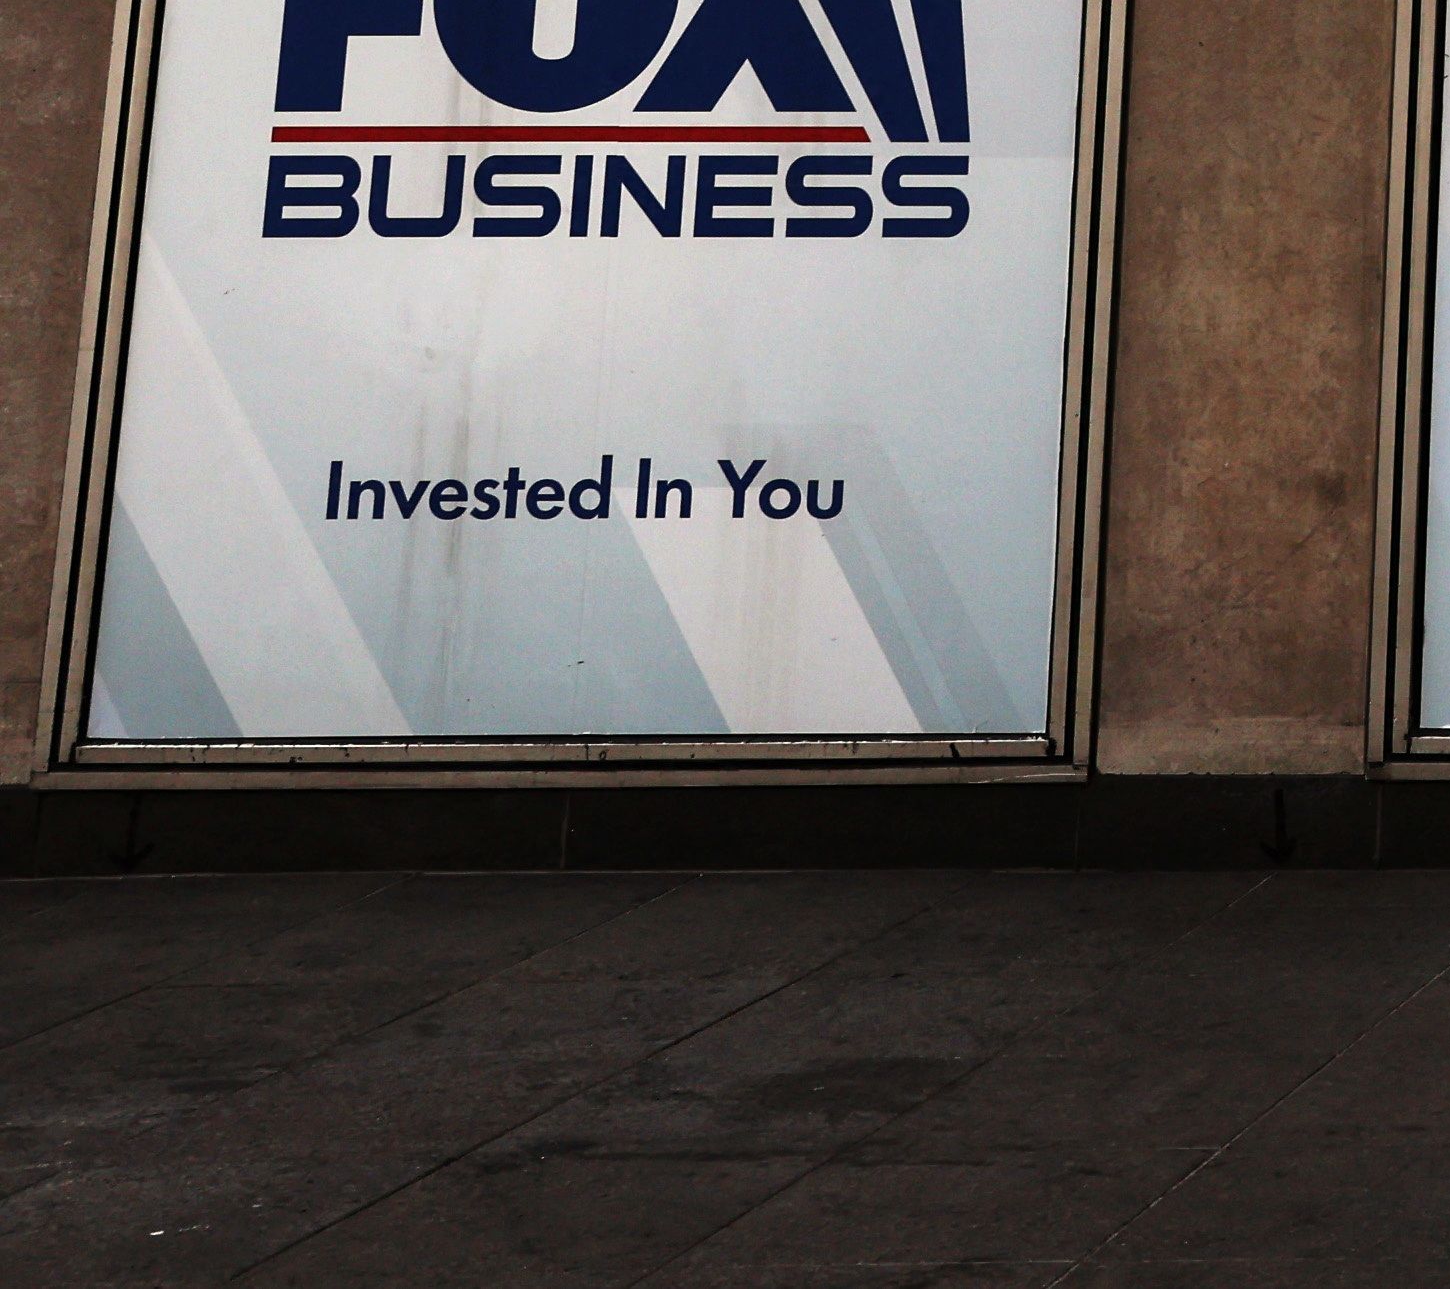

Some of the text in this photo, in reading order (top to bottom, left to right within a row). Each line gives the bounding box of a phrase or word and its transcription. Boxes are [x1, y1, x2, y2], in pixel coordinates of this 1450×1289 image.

[262, 154, 970, 238] BUSINESS
[325, 454, 845, 521] Invested In You
